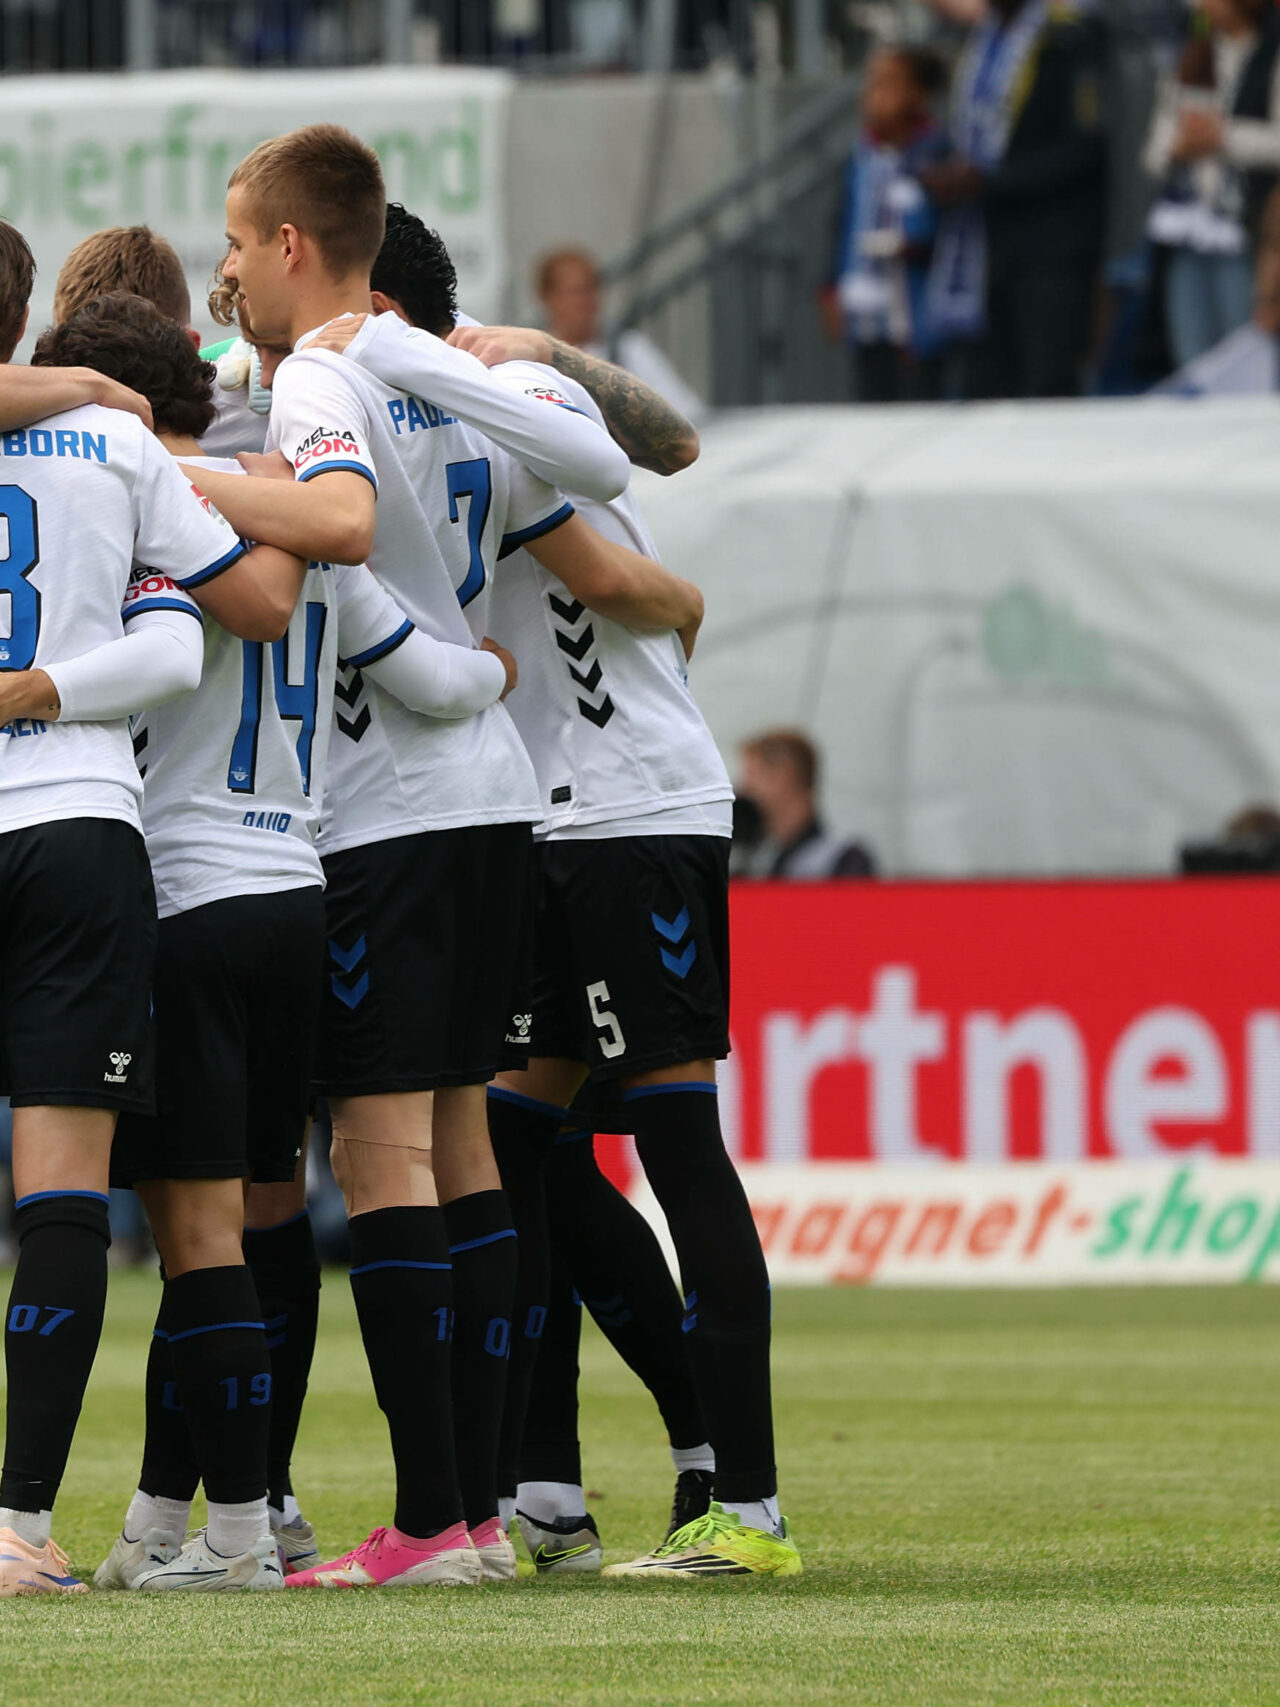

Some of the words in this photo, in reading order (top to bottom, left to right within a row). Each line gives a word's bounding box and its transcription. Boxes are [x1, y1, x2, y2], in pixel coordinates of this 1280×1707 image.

[294, 438, 360, 469] COM
[296, 426, 357, 456] MEDIA
[445, 457, 493, 611] 7
[227, 601, 328, 797] 14
[586, 979, 626, 1059] 5
[8, 1304, 76, 1337] 07
[219, 1372, 272, 1411] 19
